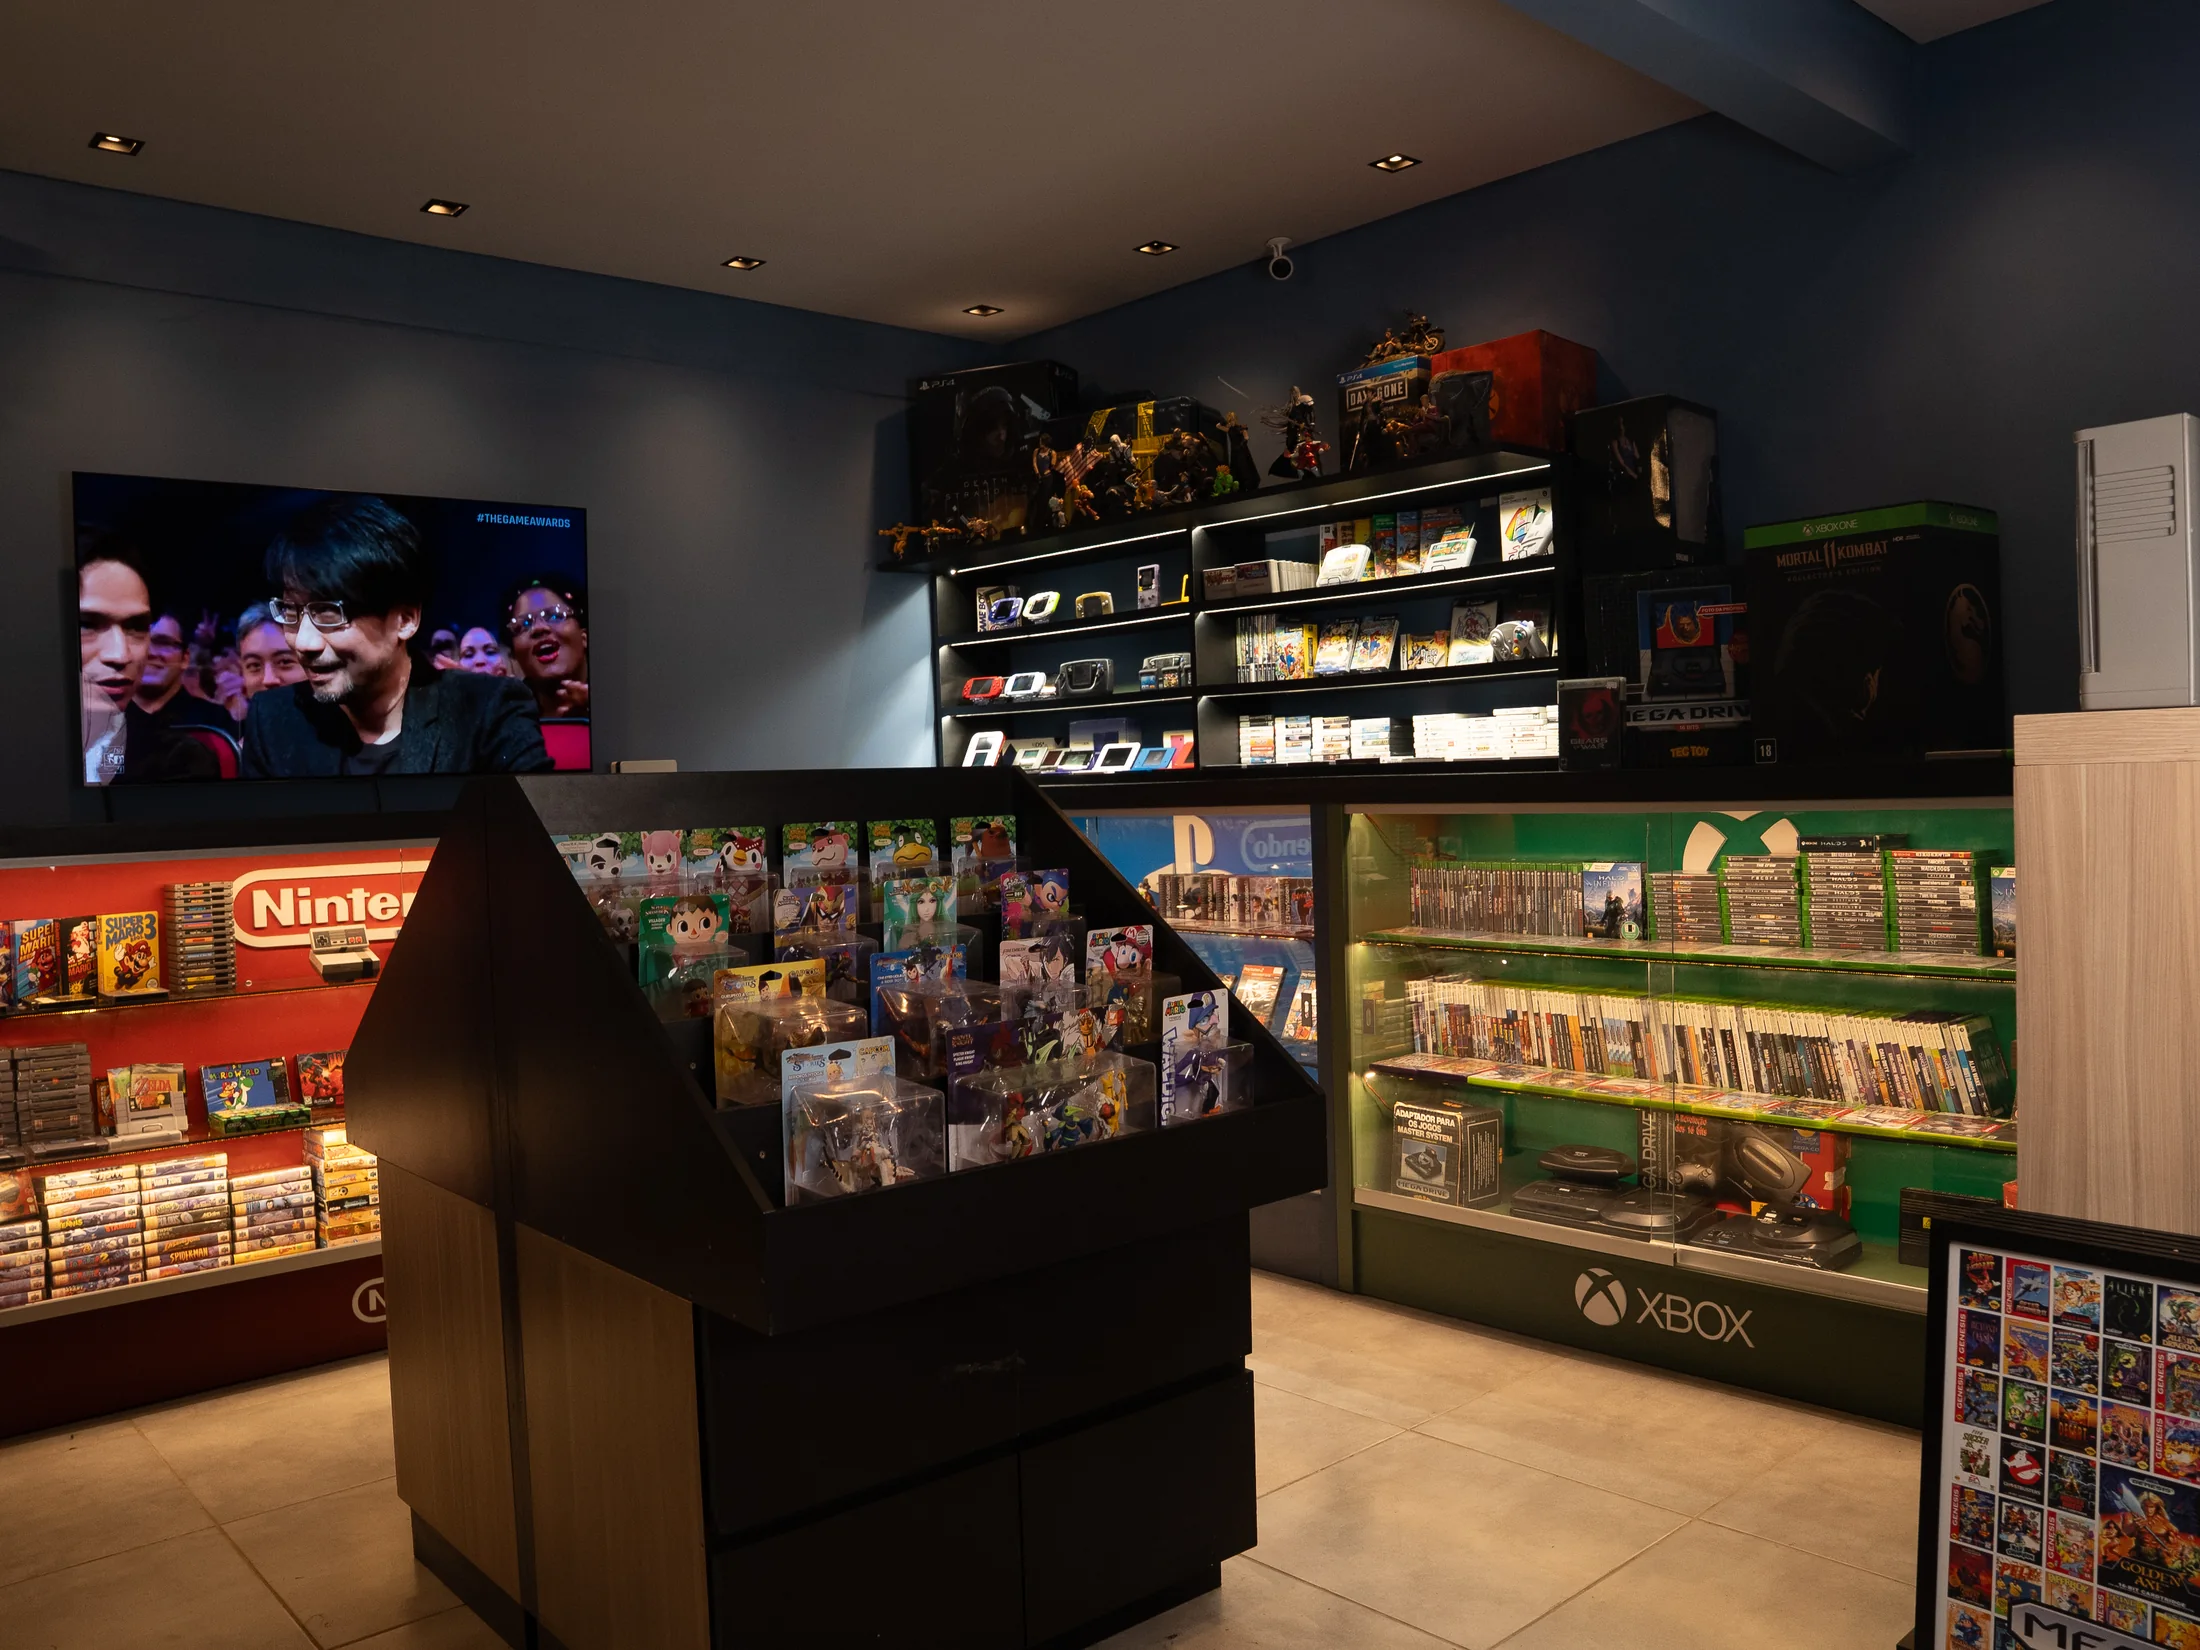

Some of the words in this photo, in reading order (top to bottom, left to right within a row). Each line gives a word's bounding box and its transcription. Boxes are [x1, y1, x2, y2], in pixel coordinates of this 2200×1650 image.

[931, 378, 956, 389] PS4
[1346, 372, 1363, 382] PS4
[1377, 380, 1404, 398] GONE
[963, 477, 1008, 489] DEATH
[477, 513, 571, 528] #THEGAMEAWARDS
[1815, 522, 1838, 534] XBOX
[1838, 519, 1858, 530] ONE
[1776, 548, 1824, 569] MORTAL
[1837, 541, 1889, 561] KOMBAT
[978, 610, 986, 633] AME
[1570, 737, 1608, 745] GEARS
[1690, 745, 1709, 757] TOY
[1759, 744, 1772, 759] 18
[105, 915, 143, 934] SUPER
[144, 913, 157, 941] 3
[105, 924, 144, 951] MARIO
[1089, 938, 1110, 948] MARIO
[1092, 932, 1108, 940] SUPER
[68, 962, 93, 977] MARIO
[1165, 1005, 1186, 1016] MARIO
[859, 1045, 890, 1056] CAPCOM
[234, 1067, 260, 1078] WORLD
[1968, 1060, 1976, 1073] ALAN
[1972, 1073, 1981, 1087] WAKE
[135, 1074, 172, 1096] ZELDA
[1395, 1109, 1436, 1124] ADAPTADOR
[1437, 1117, 1455, 1127] PARA
[1408, 1120, 1418, 1128] OS
[1418, 1123, 1442, 1133] JOGOS
[1397, 1126, 1425, 1138] MASTER
[1426, 1131, 1453, 1143] SYSTEM
[1642, 1110, 1656, 1162] DRIVE
[1687, 1126, 1695, 1136] 16
[1642, 1165, 1656, 1189] GA
[1398, 1179, 1422, 1191] MEGA
[1422, 1185, 1448, 1198] DRIVE
[60, 1218, 83, 1229] TENNIS
[169, 1247, 208, 1264] SPIDER-MAN
[2106, 1280, 2146, 1299] ALIEN
[1636, 1287, 1756, 1349] XBOX
[1958, 1313, 1967, 1354] GENESIS
[2157, 1354, 2165, 1394] GENESIS
[1956, 1371, 1964, 1409] GENESIS
[1962, 1432, 1990, 1446] SOCCER
[2059, 1421, 2088, 1441] DESERT
[2156, 1417, 2164, 1460] GENESIS
[2003, 1481, 2041, 1496] GHOSTBUSTERS
[2132, 1480, 2172, 1495] GENESIS
[1952, 1488, 1960, 1527] GENESIS
[2047, 1515, 2056, 1559] GENESIS
[2120, 1557, 2182, 1588] GOLDEN
[2048, 1573, 2090, 1593] PAPERBOY
[2135, 1575, 2161, 1592] AXE
[2097, 1593, 2106, 1624] NESIS
